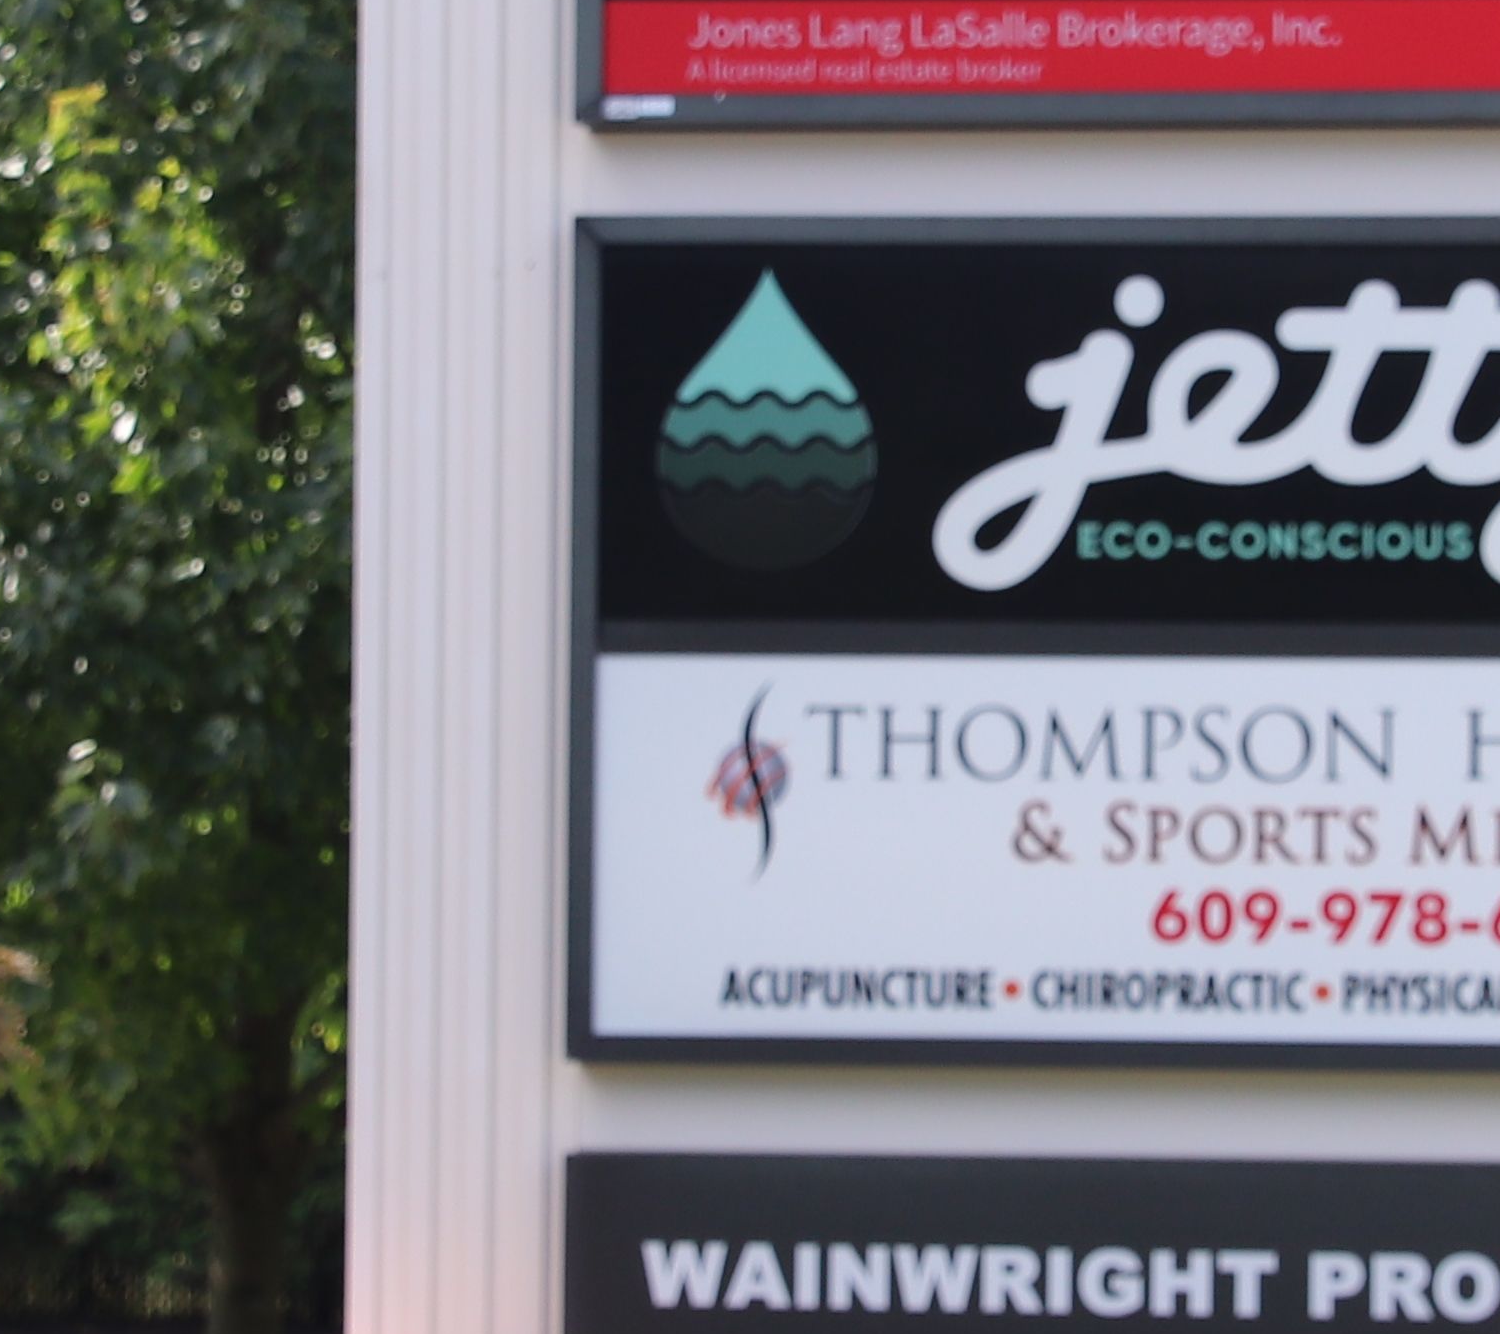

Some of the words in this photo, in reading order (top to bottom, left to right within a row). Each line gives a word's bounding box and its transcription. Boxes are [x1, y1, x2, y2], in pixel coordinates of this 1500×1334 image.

[688, 13, 800, 49] Jones
[809, 12, 904, 57] Lang
[910, 11, 1051, 49] LaSalle
[1057, 11, 1265, 55] Brokerage,
[1272, 11, 1343, 48] Inc.
[1077, 522, 1474, 562] ECO-CONSCIOUS
[804, 703, 1398, 783] THOMPSON
[1010, 799, 1075, 865] &
[1102, 800, 1379, 866] SPORTS
[720, 967, 993, 1011] ACUPUNCTURE
[1032, 969, 1304, 1014] CHIROPRACTIC
[641, 1240, 1278, 1319] WAINWRIGHT
